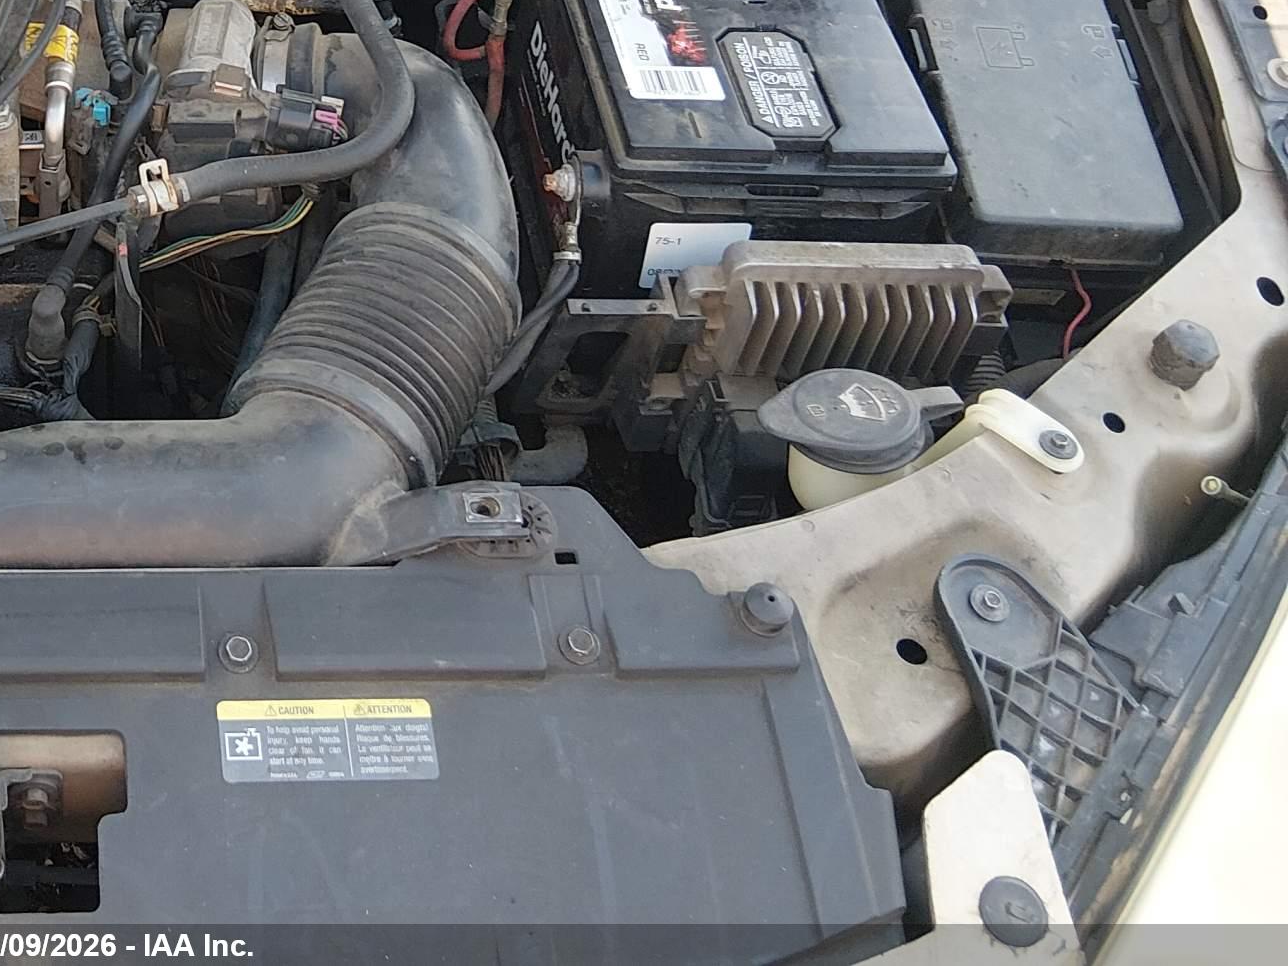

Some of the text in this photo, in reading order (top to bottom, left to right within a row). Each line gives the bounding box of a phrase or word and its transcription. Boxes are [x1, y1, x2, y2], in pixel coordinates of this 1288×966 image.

[634, 42, 650, 61] RED
[733, 42, 754, 73] POISON
[529, 20, 575, 163] DieHard
[747, 80, 771, 115] DANGER
[654, 236, 682, 246] 75-1
[278, 706, 314, 715] CAUTION
[367, 705, 412, 713] ATTENTION
